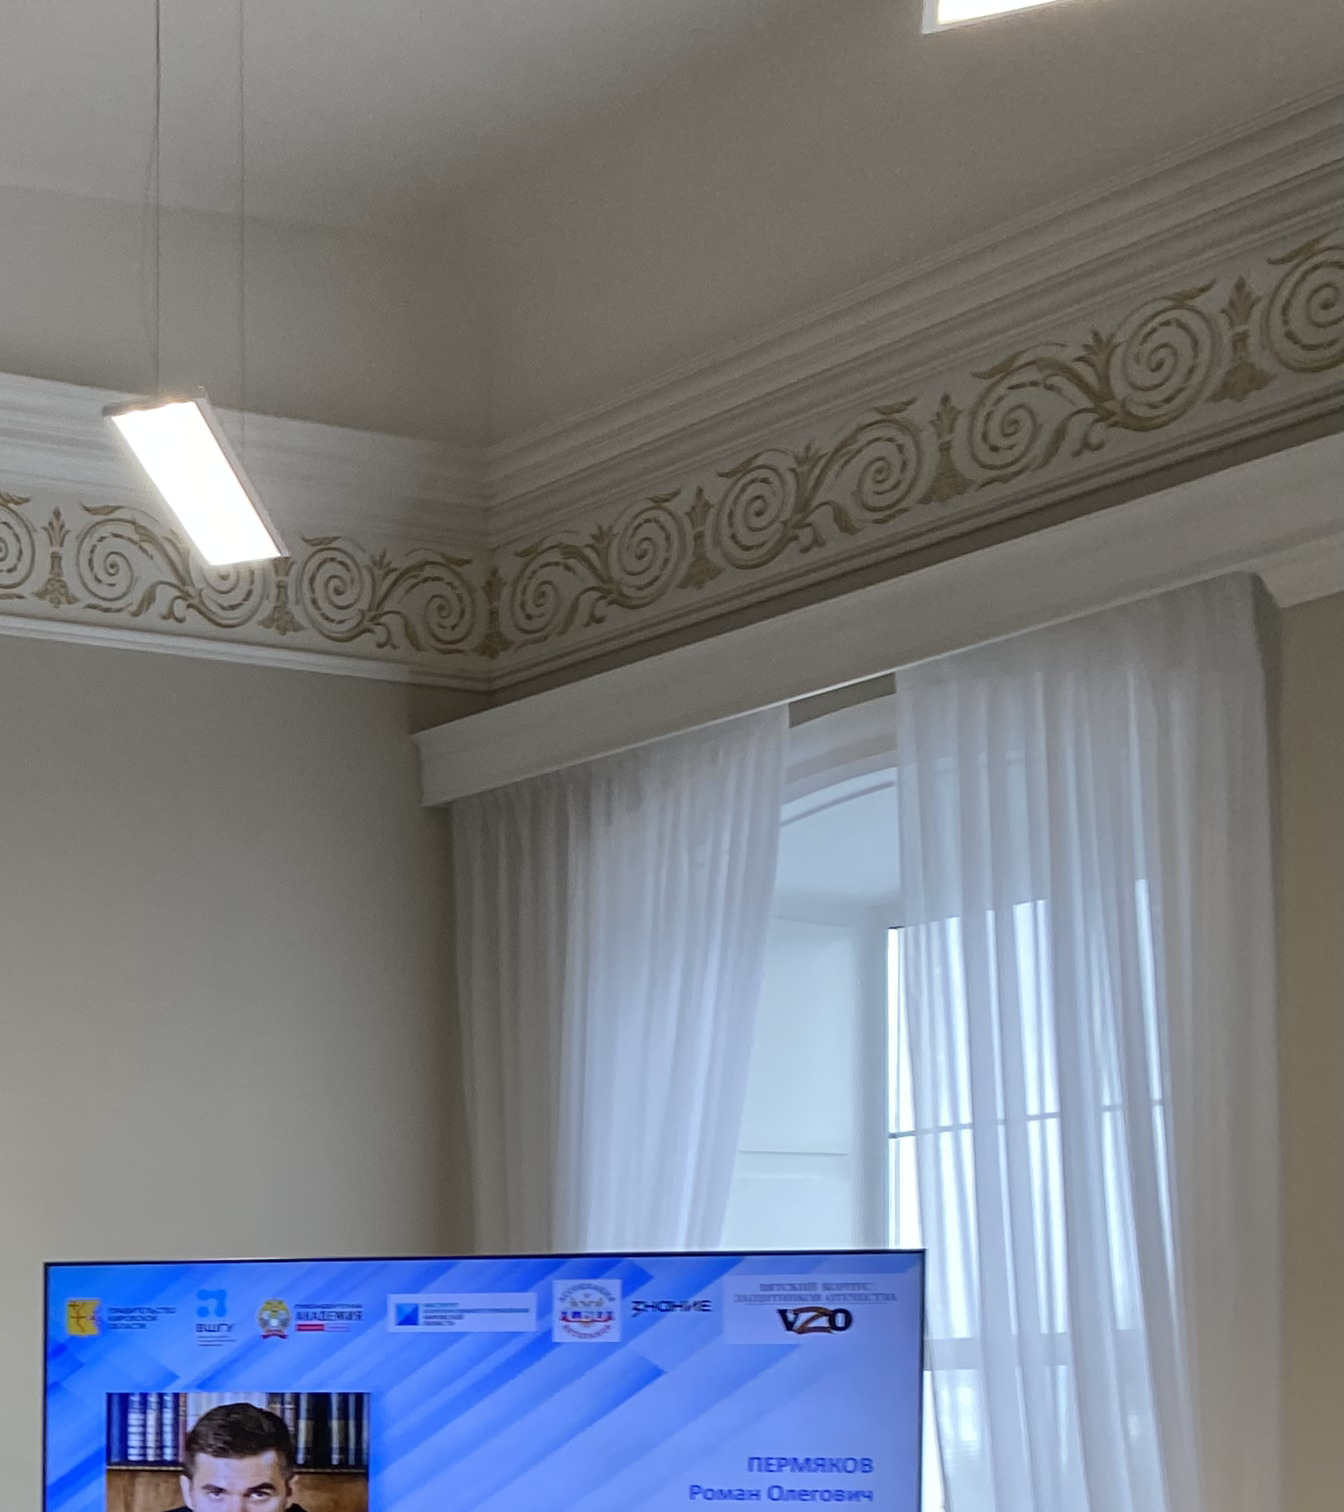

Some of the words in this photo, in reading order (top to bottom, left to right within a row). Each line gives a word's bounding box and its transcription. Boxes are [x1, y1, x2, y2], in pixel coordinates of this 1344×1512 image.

[747, 1456, 874, 1474] ПЕРМЯКОВ
[689, 1484, 761, 1501] Роман
[767, 1485, 874, 1503] Олегович
